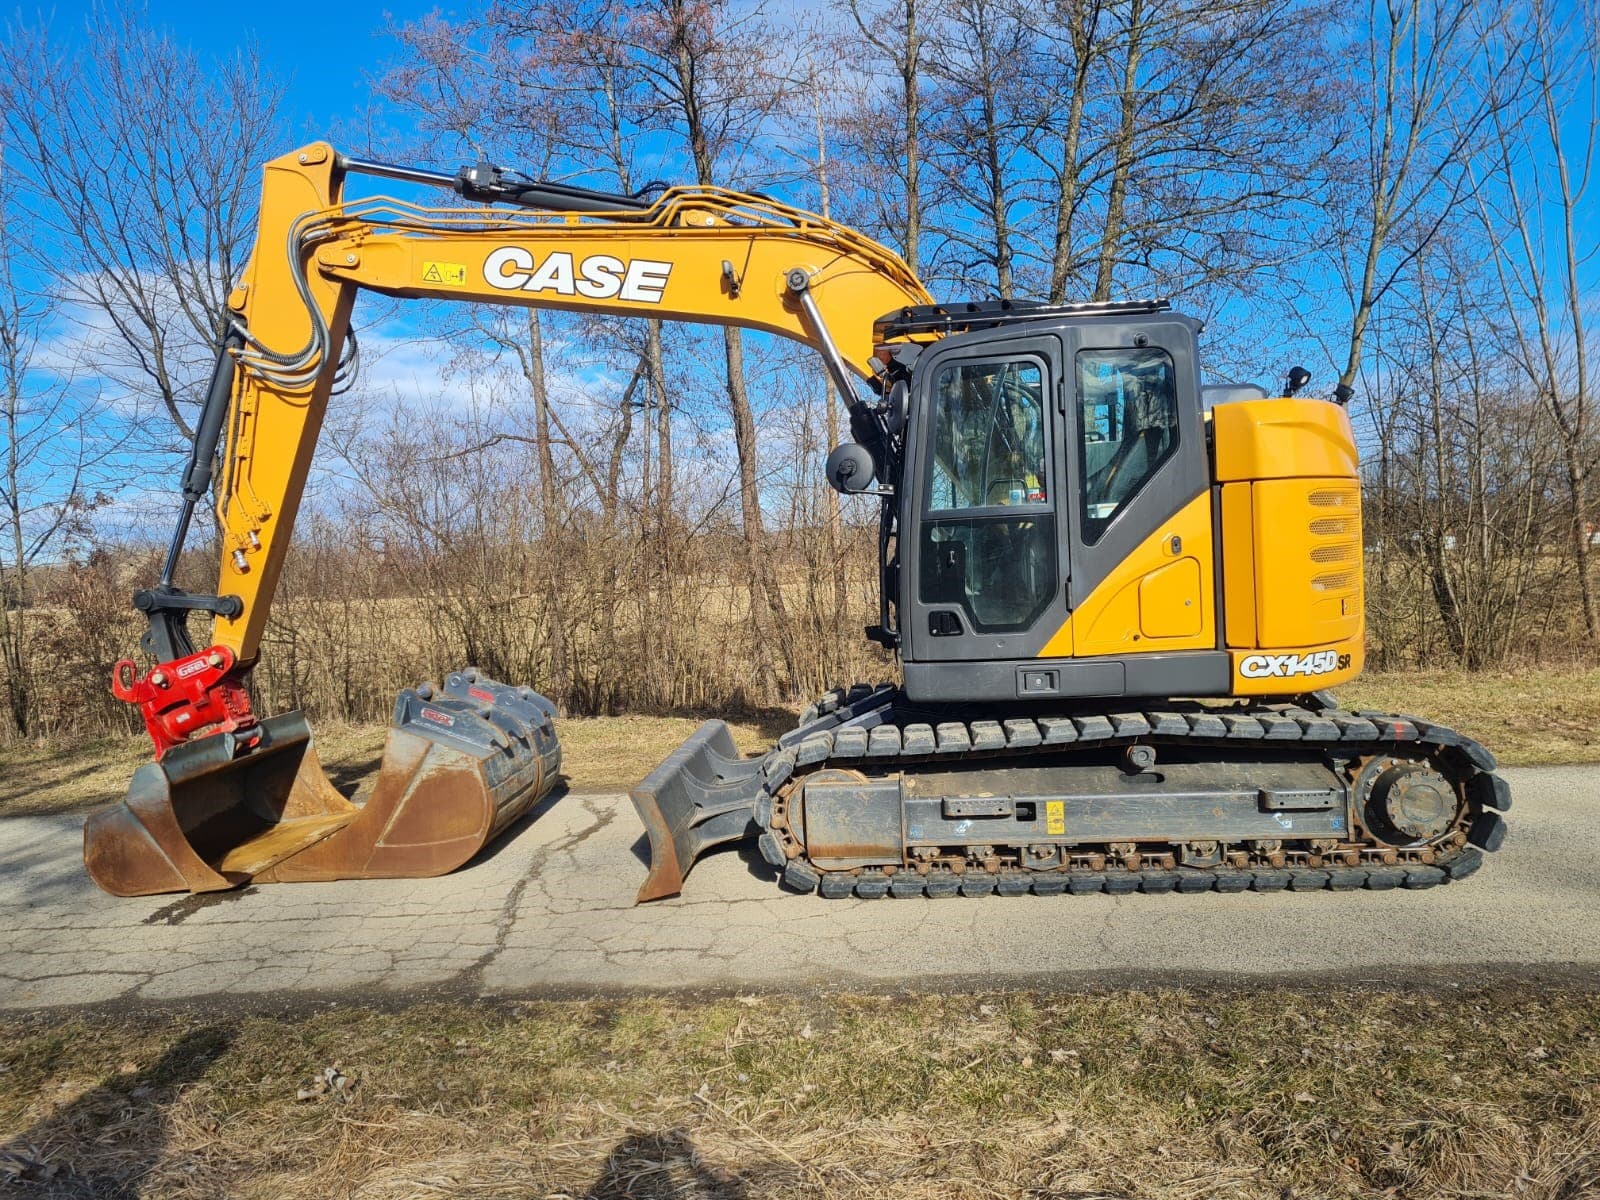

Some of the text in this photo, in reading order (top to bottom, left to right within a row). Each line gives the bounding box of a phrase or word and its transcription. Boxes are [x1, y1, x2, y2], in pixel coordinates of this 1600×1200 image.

[483, 246, 673, 303] CASE
[1240, 650, 1351, 678] CX145D SR
